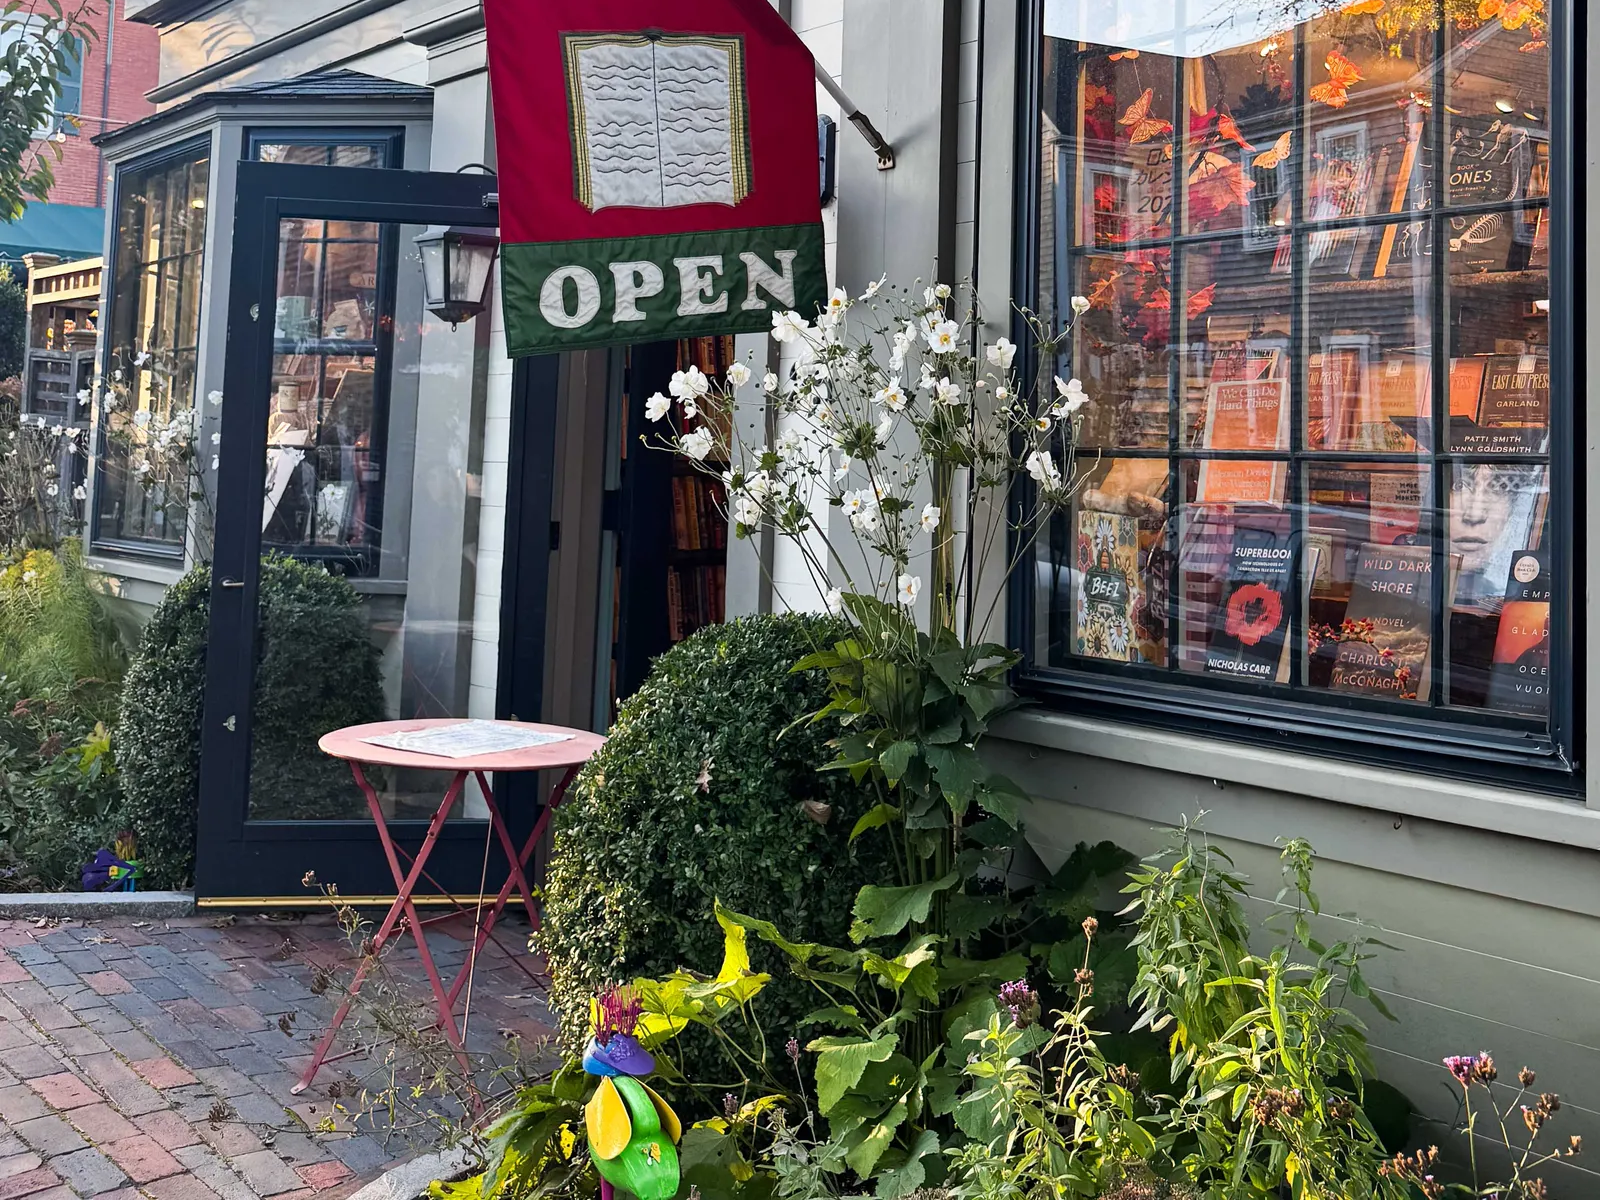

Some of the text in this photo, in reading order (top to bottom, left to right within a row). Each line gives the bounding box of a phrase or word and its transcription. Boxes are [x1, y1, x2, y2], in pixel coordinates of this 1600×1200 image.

[539, 250, 798, 329] OPEN
[1492, 375, 1509, 389] EAST
[1511, 374, 1527, 389] END
[1222, 386, 1276, 399] We Can Do
[1218, 397, 1279, 411] Hard Things
[1496, 400, 1540, 408] GARLAND
[1492, 435, 1522, 443] SMITH
[1477, 445, 1532, 453] GOLDSMITH
[1364, 559, 1432, 573] WILD DARK
[1090, 576, 1120, 598] BEEZ
[1371, 580, 1413, 594] SHORE
[1374, 618, 1404, 627] NOVEL
[1208, 658, 1249, 672] NICHOLAS
[1249, 663, 1271, 675] CARR
